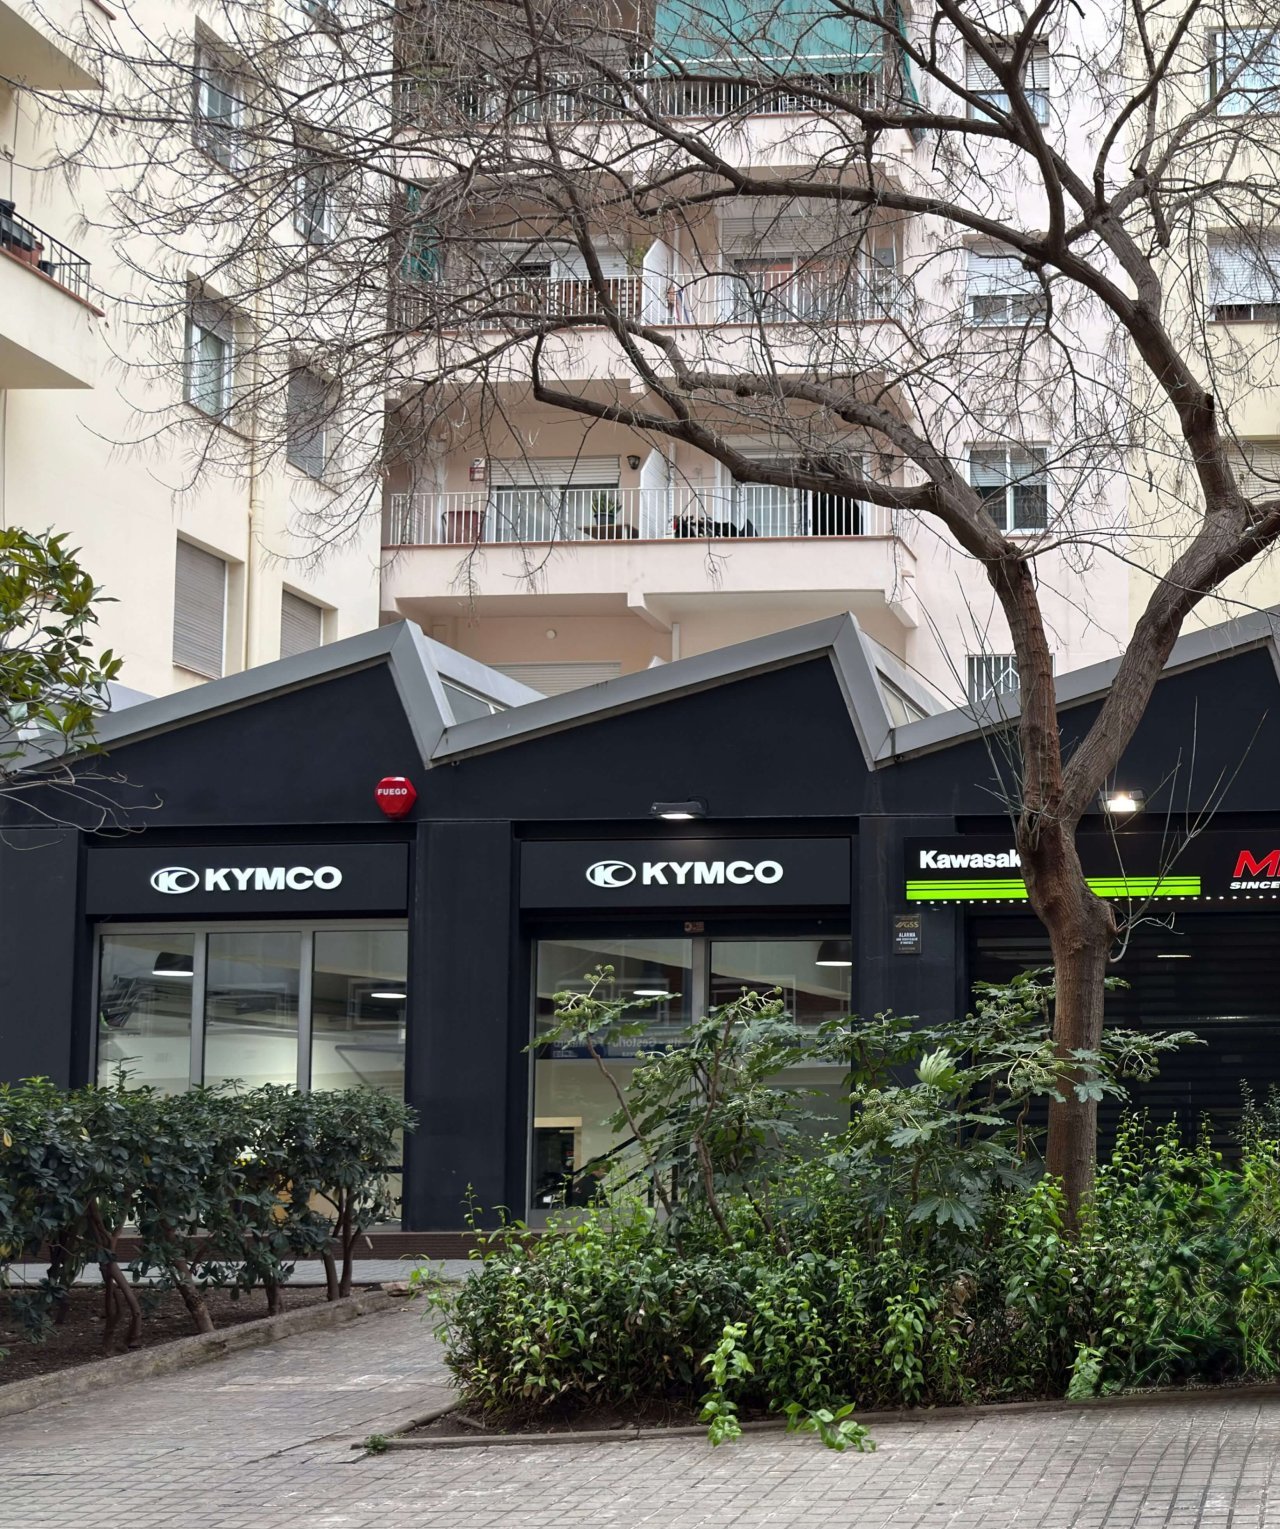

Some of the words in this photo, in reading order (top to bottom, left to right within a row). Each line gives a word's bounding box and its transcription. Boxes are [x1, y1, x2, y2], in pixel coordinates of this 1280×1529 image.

[377, 788, 408, 796] FUEGO
[919, 849, 1022, 869] Kawasak
[205, 866, 342, 891] KYMCO
[642, 860, 784, 885] KYMCO
[1229, 881, 1280, 890] SINCE
